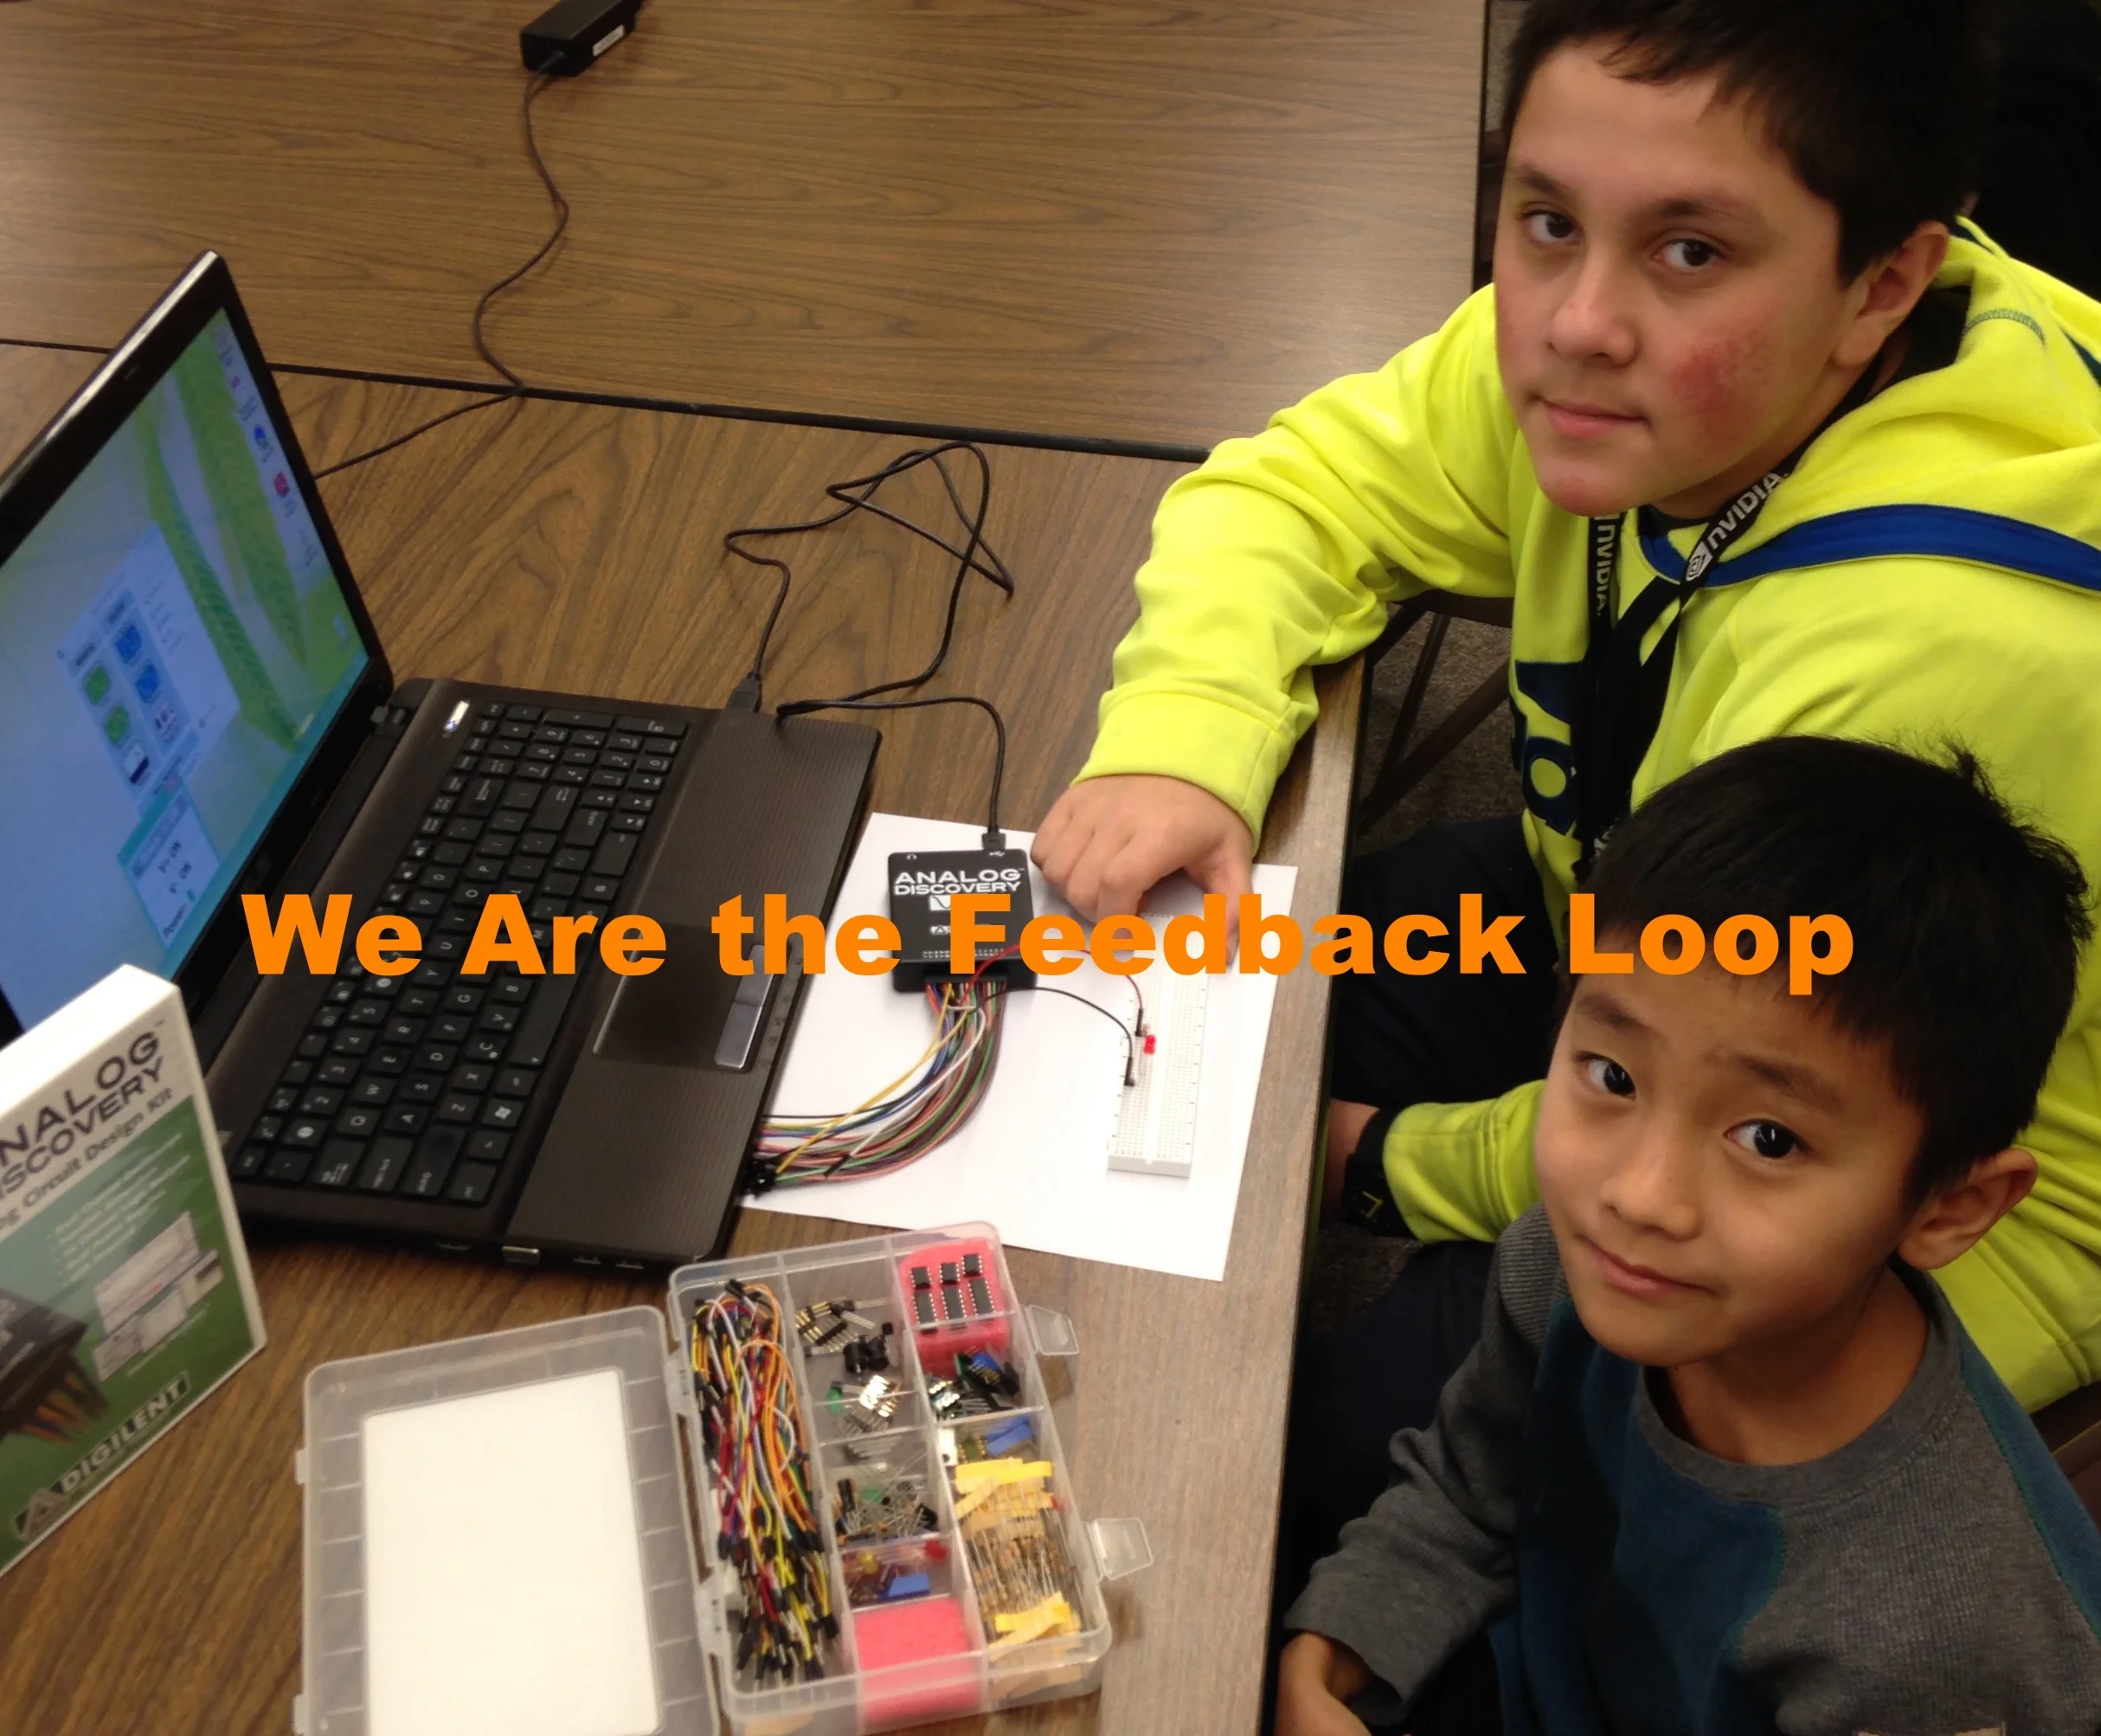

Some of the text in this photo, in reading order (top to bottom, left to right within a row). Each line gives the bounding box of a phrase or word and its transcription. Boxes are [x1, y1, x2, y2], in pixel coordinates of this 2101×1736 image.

[895, 868, 1022, 884] ANALOG
[895, 881, 1021, 896] DISCOVERY
[0, 1056, 164, 1199] SCOVERY
[61, 1379, 187, 1494] DIGILENT
